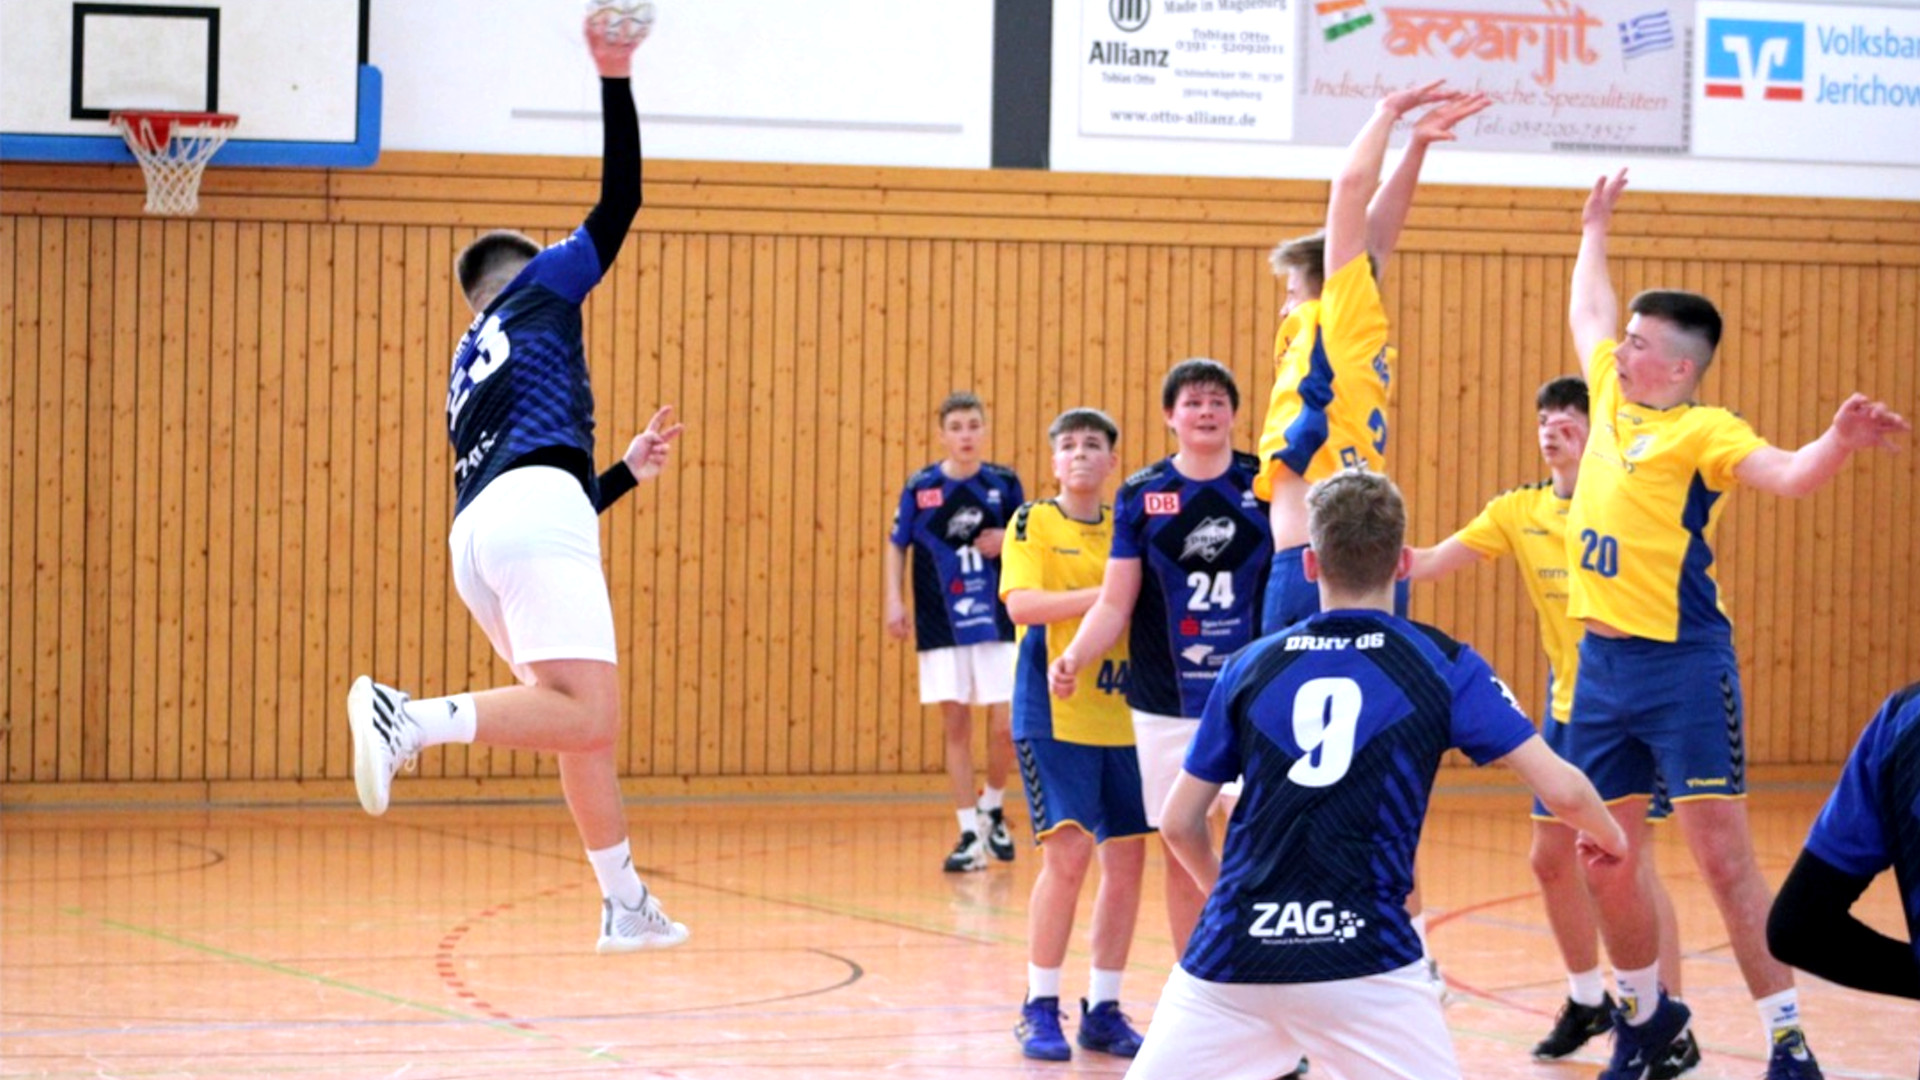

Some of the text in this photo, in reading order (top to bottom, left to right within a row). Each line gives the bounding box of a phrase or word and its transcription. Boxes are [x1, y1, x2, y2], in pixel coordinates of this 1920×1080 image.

[1191, 28, 1270, 43] Tobias Otto
[1817, 24, 1920, 59] Volksba
[1088, 40, 1170, 68] Allianz
[1101, 72, 1156, 85] Tobias Otto
[1110, 110, 1257, 127] www.otto-allianz.de
[1148, 495, 1177, 512] DB
[955, 544, 984, 574] 11
[1580, 528, 1619, 578] 20
[1186, 571, 1236, 611] 24
[1284, 632, 1385, 651] DRHV 06
[1096, 659, 1130, 695] 44
[1287, 676, 1363, 788] 9
[1248, 900, 1336, 937] ZAG
